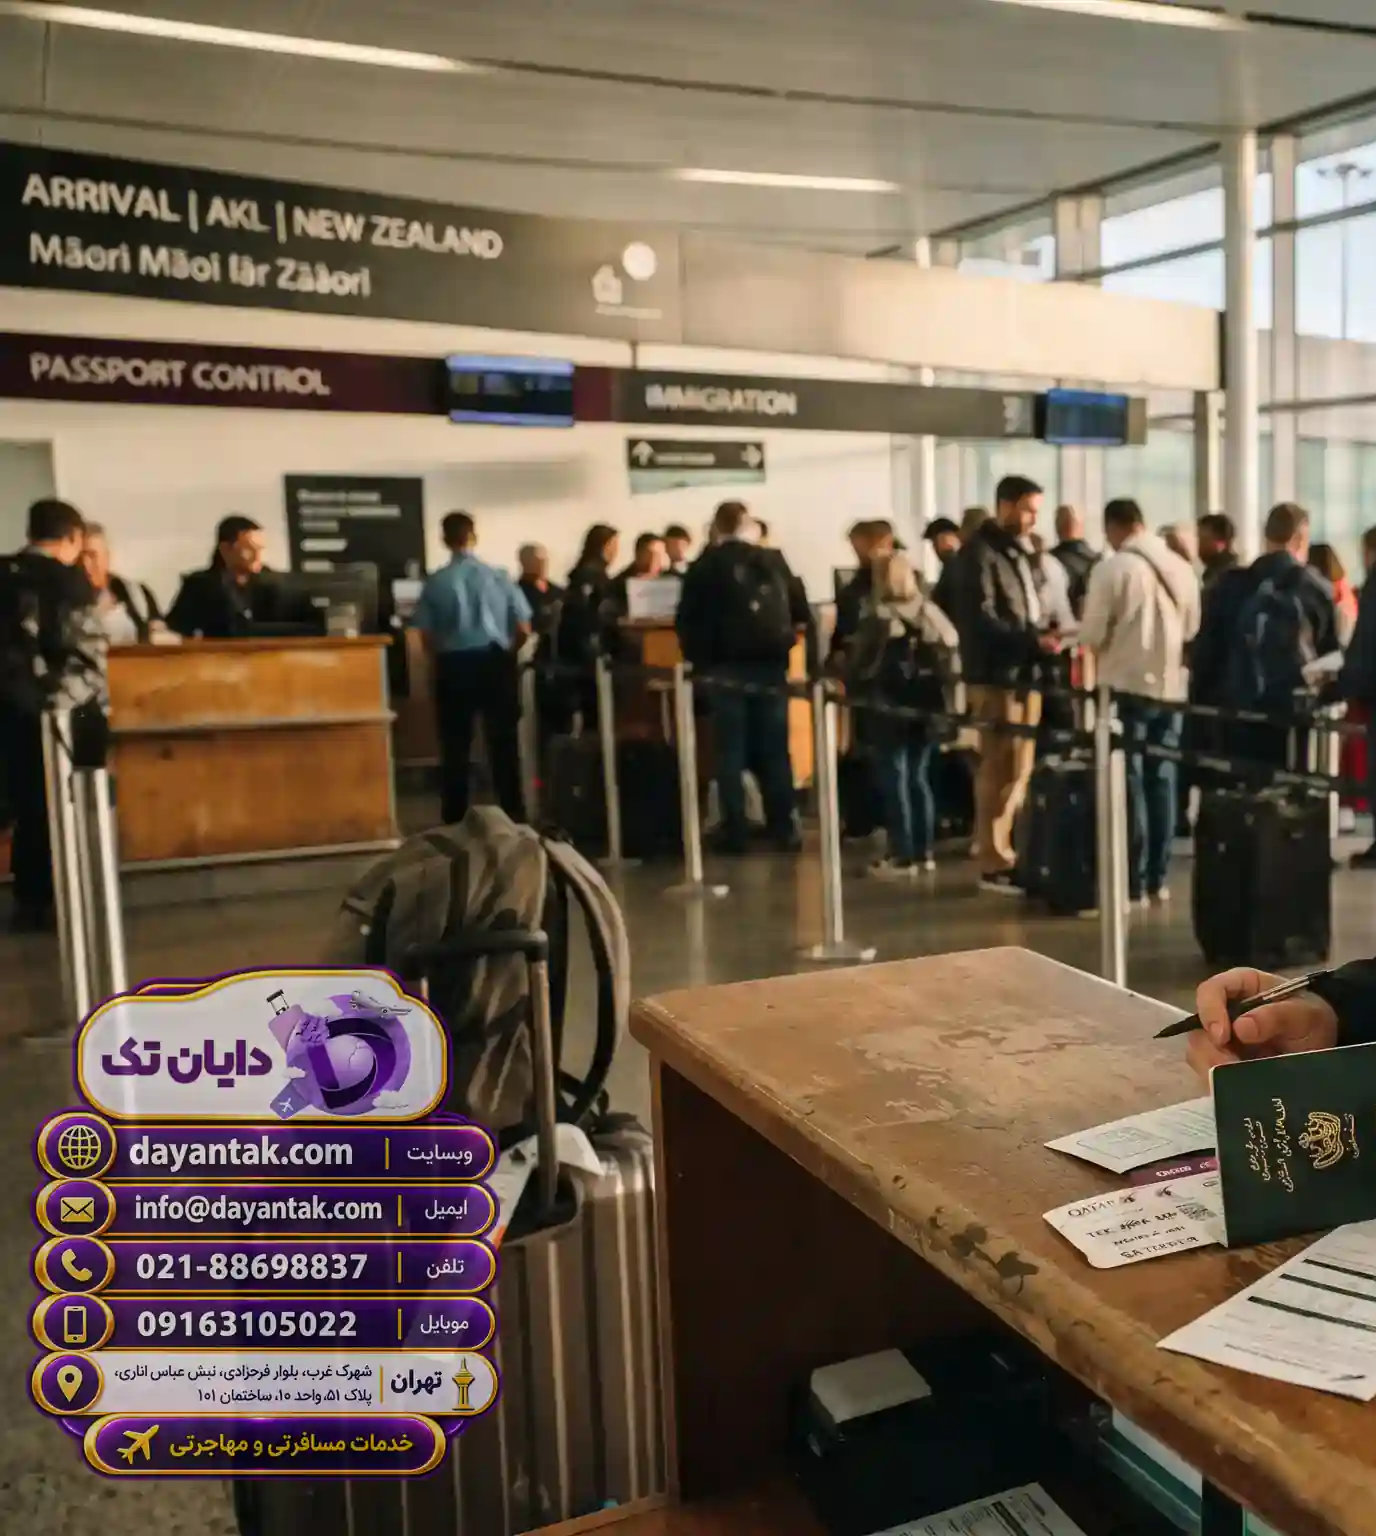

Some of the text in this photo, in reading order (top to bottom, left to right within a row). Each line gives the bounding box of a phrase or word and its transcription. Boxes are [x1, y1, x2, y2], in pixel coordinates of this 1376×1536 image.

[21, 172, 182, 222] ARRIVAL
[206, 195, 271, 232] AKL
[293, 205, 365, 243] NEW
[369, 214, 504, 260] ZEALAND
[29, 352, 332, 396] PASSPORT CONTROL
[645, 383, 798, 415] IMMIGRATION
